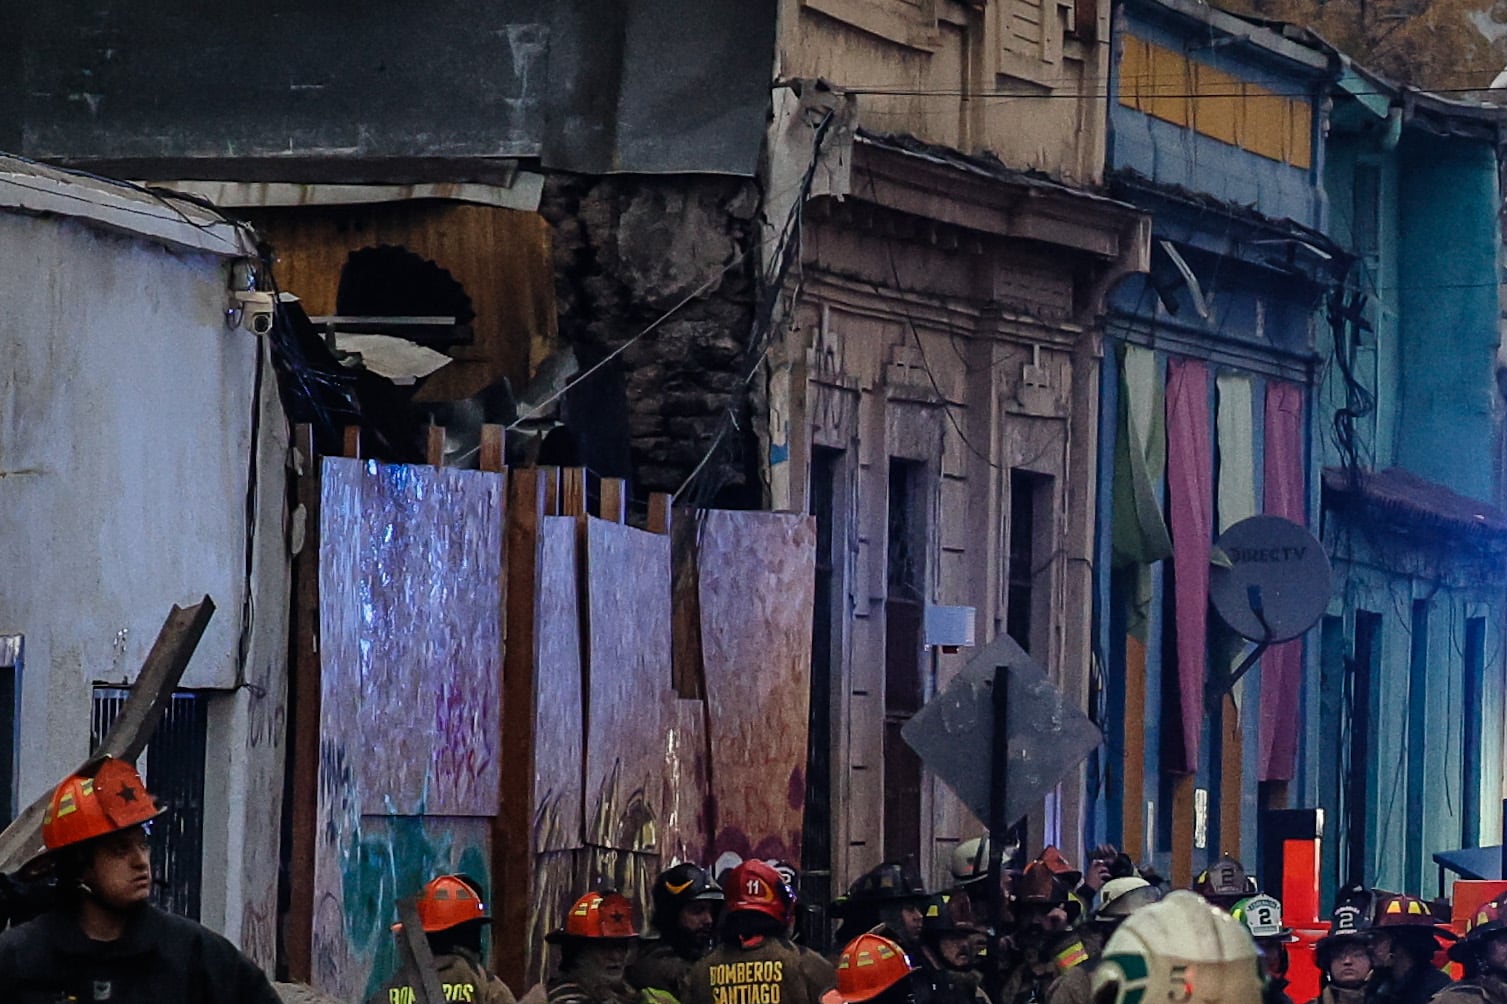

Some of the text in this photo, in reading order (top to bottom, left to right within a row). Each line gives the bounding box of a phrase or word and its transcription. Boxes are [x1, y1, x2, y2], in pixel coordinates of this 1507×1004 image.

[746, 879, 760, 895] 11
[1258, 908, 1272, 925] 2
[1339, 912, 1354, 929] 2
[709, 960, 784, 986] BOMBEROS
[1167, 964, 1194, 1004] 5
